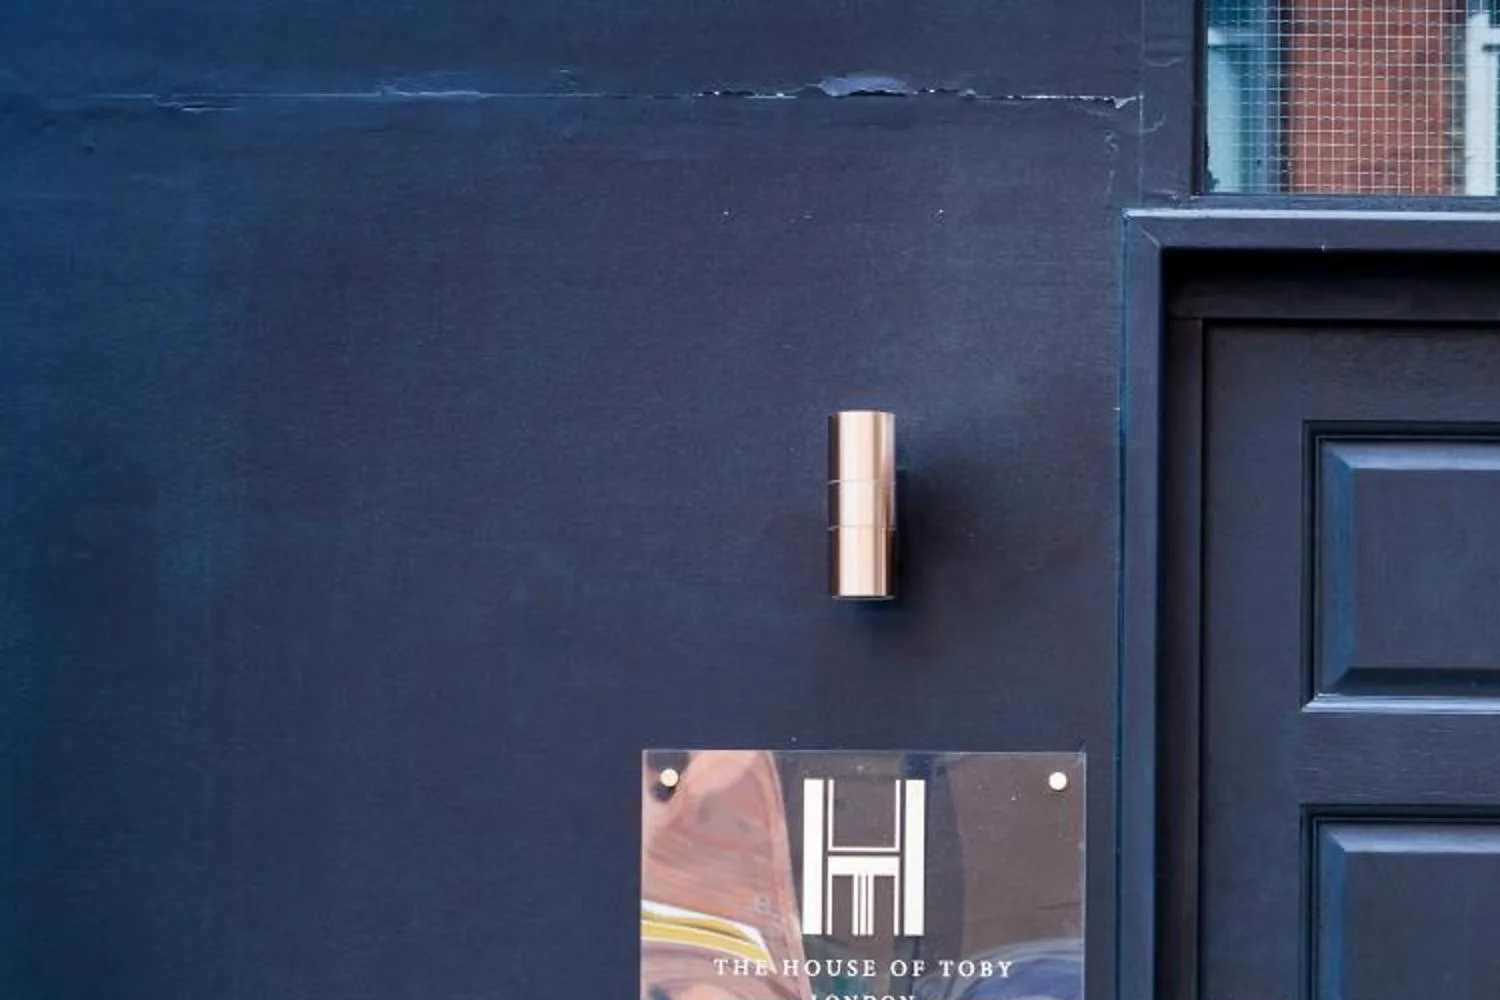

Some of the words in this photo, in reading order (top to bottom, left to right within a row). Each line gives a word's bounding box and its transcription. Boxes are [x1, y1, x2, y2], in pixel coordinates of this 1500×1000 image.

[714, 959, 770, 977] THE
[783, 959, 877, 977] HOUSE
[890, 959, 925, 977] OF
[938, 959, 1013, 978] TOBY
